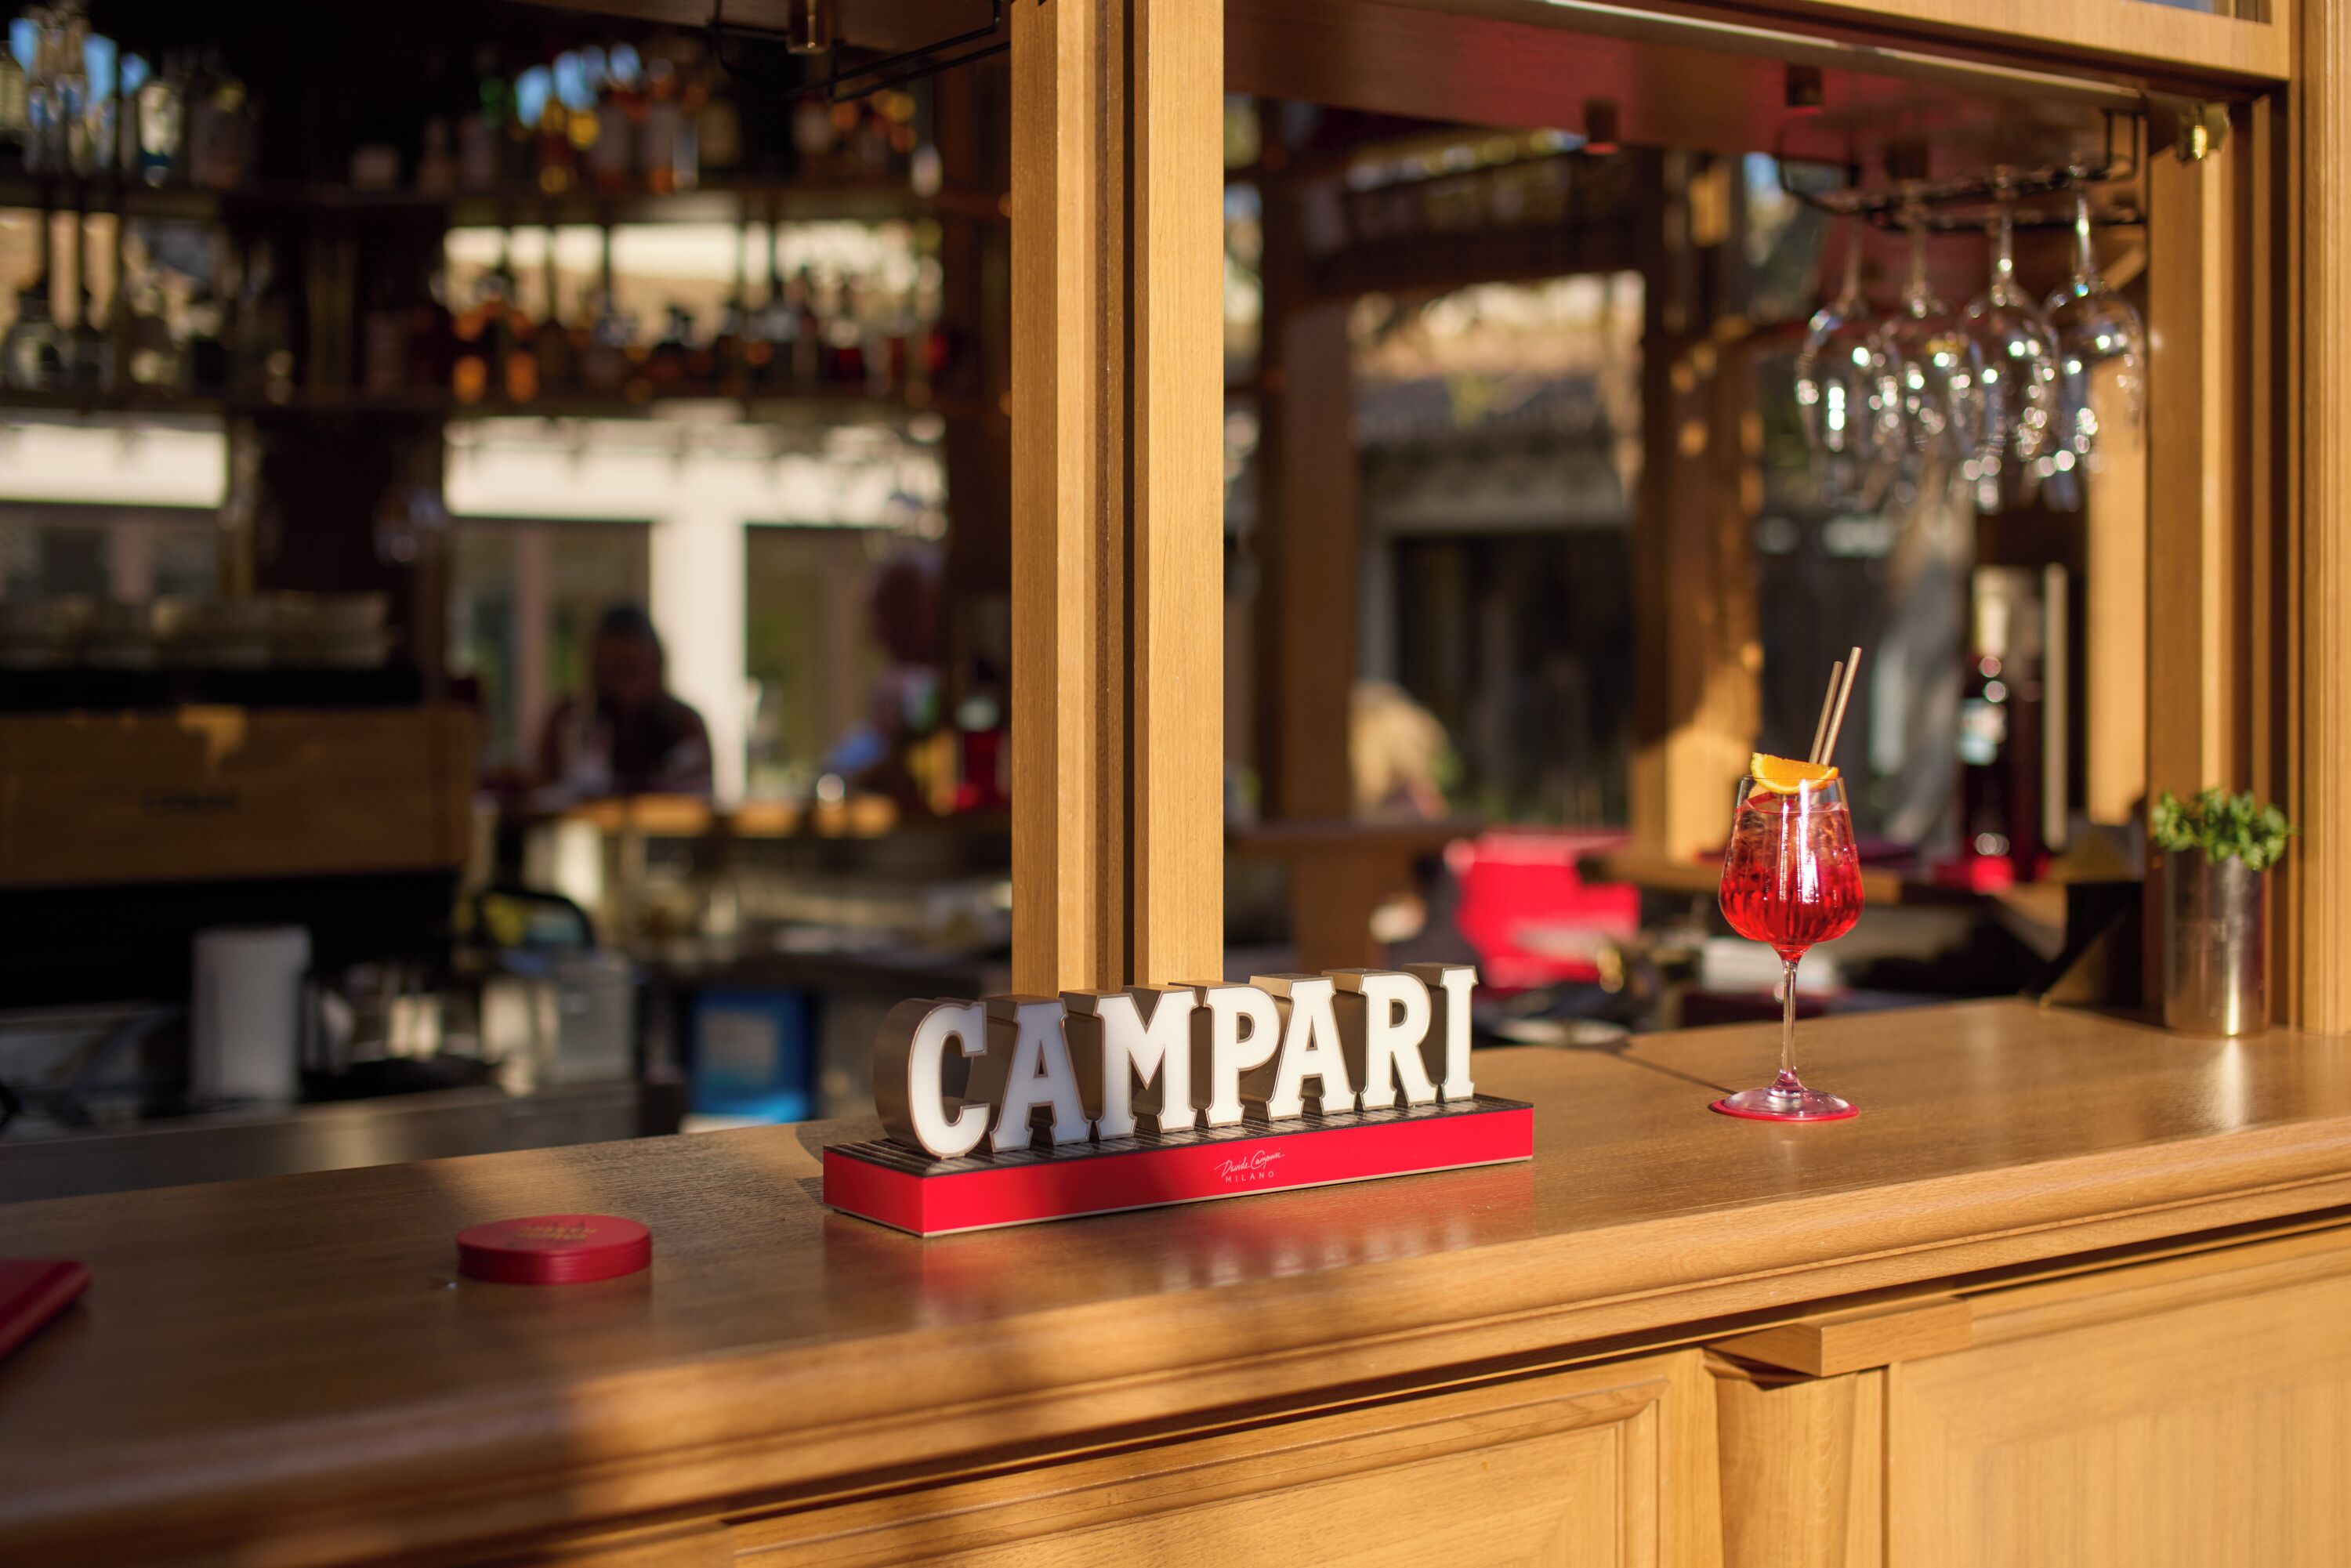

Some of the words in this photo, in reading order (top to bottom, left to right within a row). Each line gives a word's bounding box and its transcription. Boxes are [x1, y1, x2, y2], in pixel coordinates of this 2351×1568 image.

[907, 965, 1479, 1158] CAMPARI
[1215, 1156, 1251, 1178] Davide
[1250, 1148, 1285, 1170] Campari
[1225, 1171, 1275, 1183] MILANO
